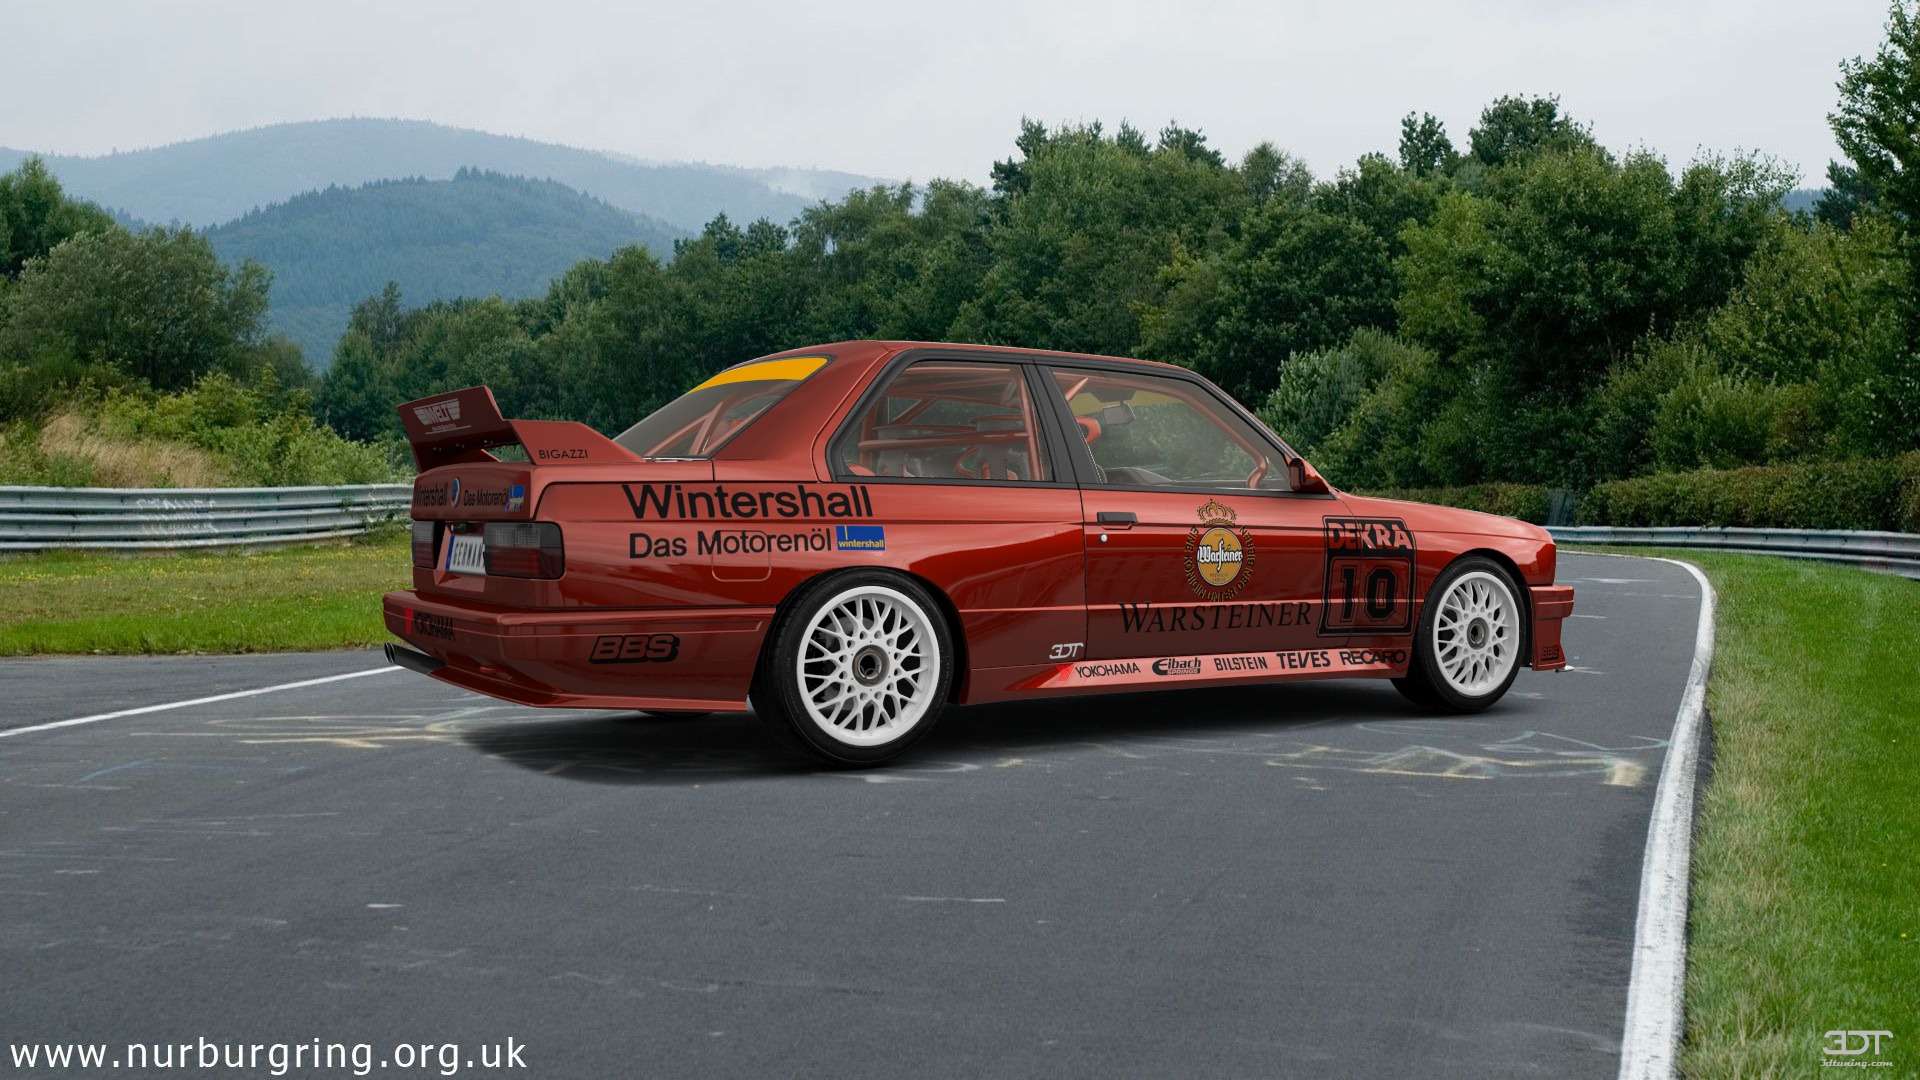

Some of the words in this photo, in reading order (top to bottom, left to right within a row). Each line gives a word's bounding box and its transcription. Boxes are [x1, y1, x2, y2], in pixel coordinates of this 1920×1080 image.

[538, 449, 589, 459] BIGAZZI
[463, 490, 476, 506] Das
[622, 485, 874, 519] Wintershall
[629, 532, 687, 559] Das
[697, 528, 832, 556] Motorenöl
[838, 539, 885, 548] wintershall
[1328, 522, 1414, 550] DEKRA
[1340, 565, 1398, 622] 10
[413, 610, 457, 641] YOKOHAMA
[1118, 601, 1312, 634] WARSTEINER
[589, 634, 680, 664] BBS
[1049, 643, 1084, 659] 3DT
[1340, 650, 1407, 666] RECARO
[1152, 657, 1201, 675] Eibach
[1213, 656, 1269, 671] BILSTEIN
[1276, 651, 1331, 669] TEVES
[1074, 662, 1142, 678] YOKOHAMA
